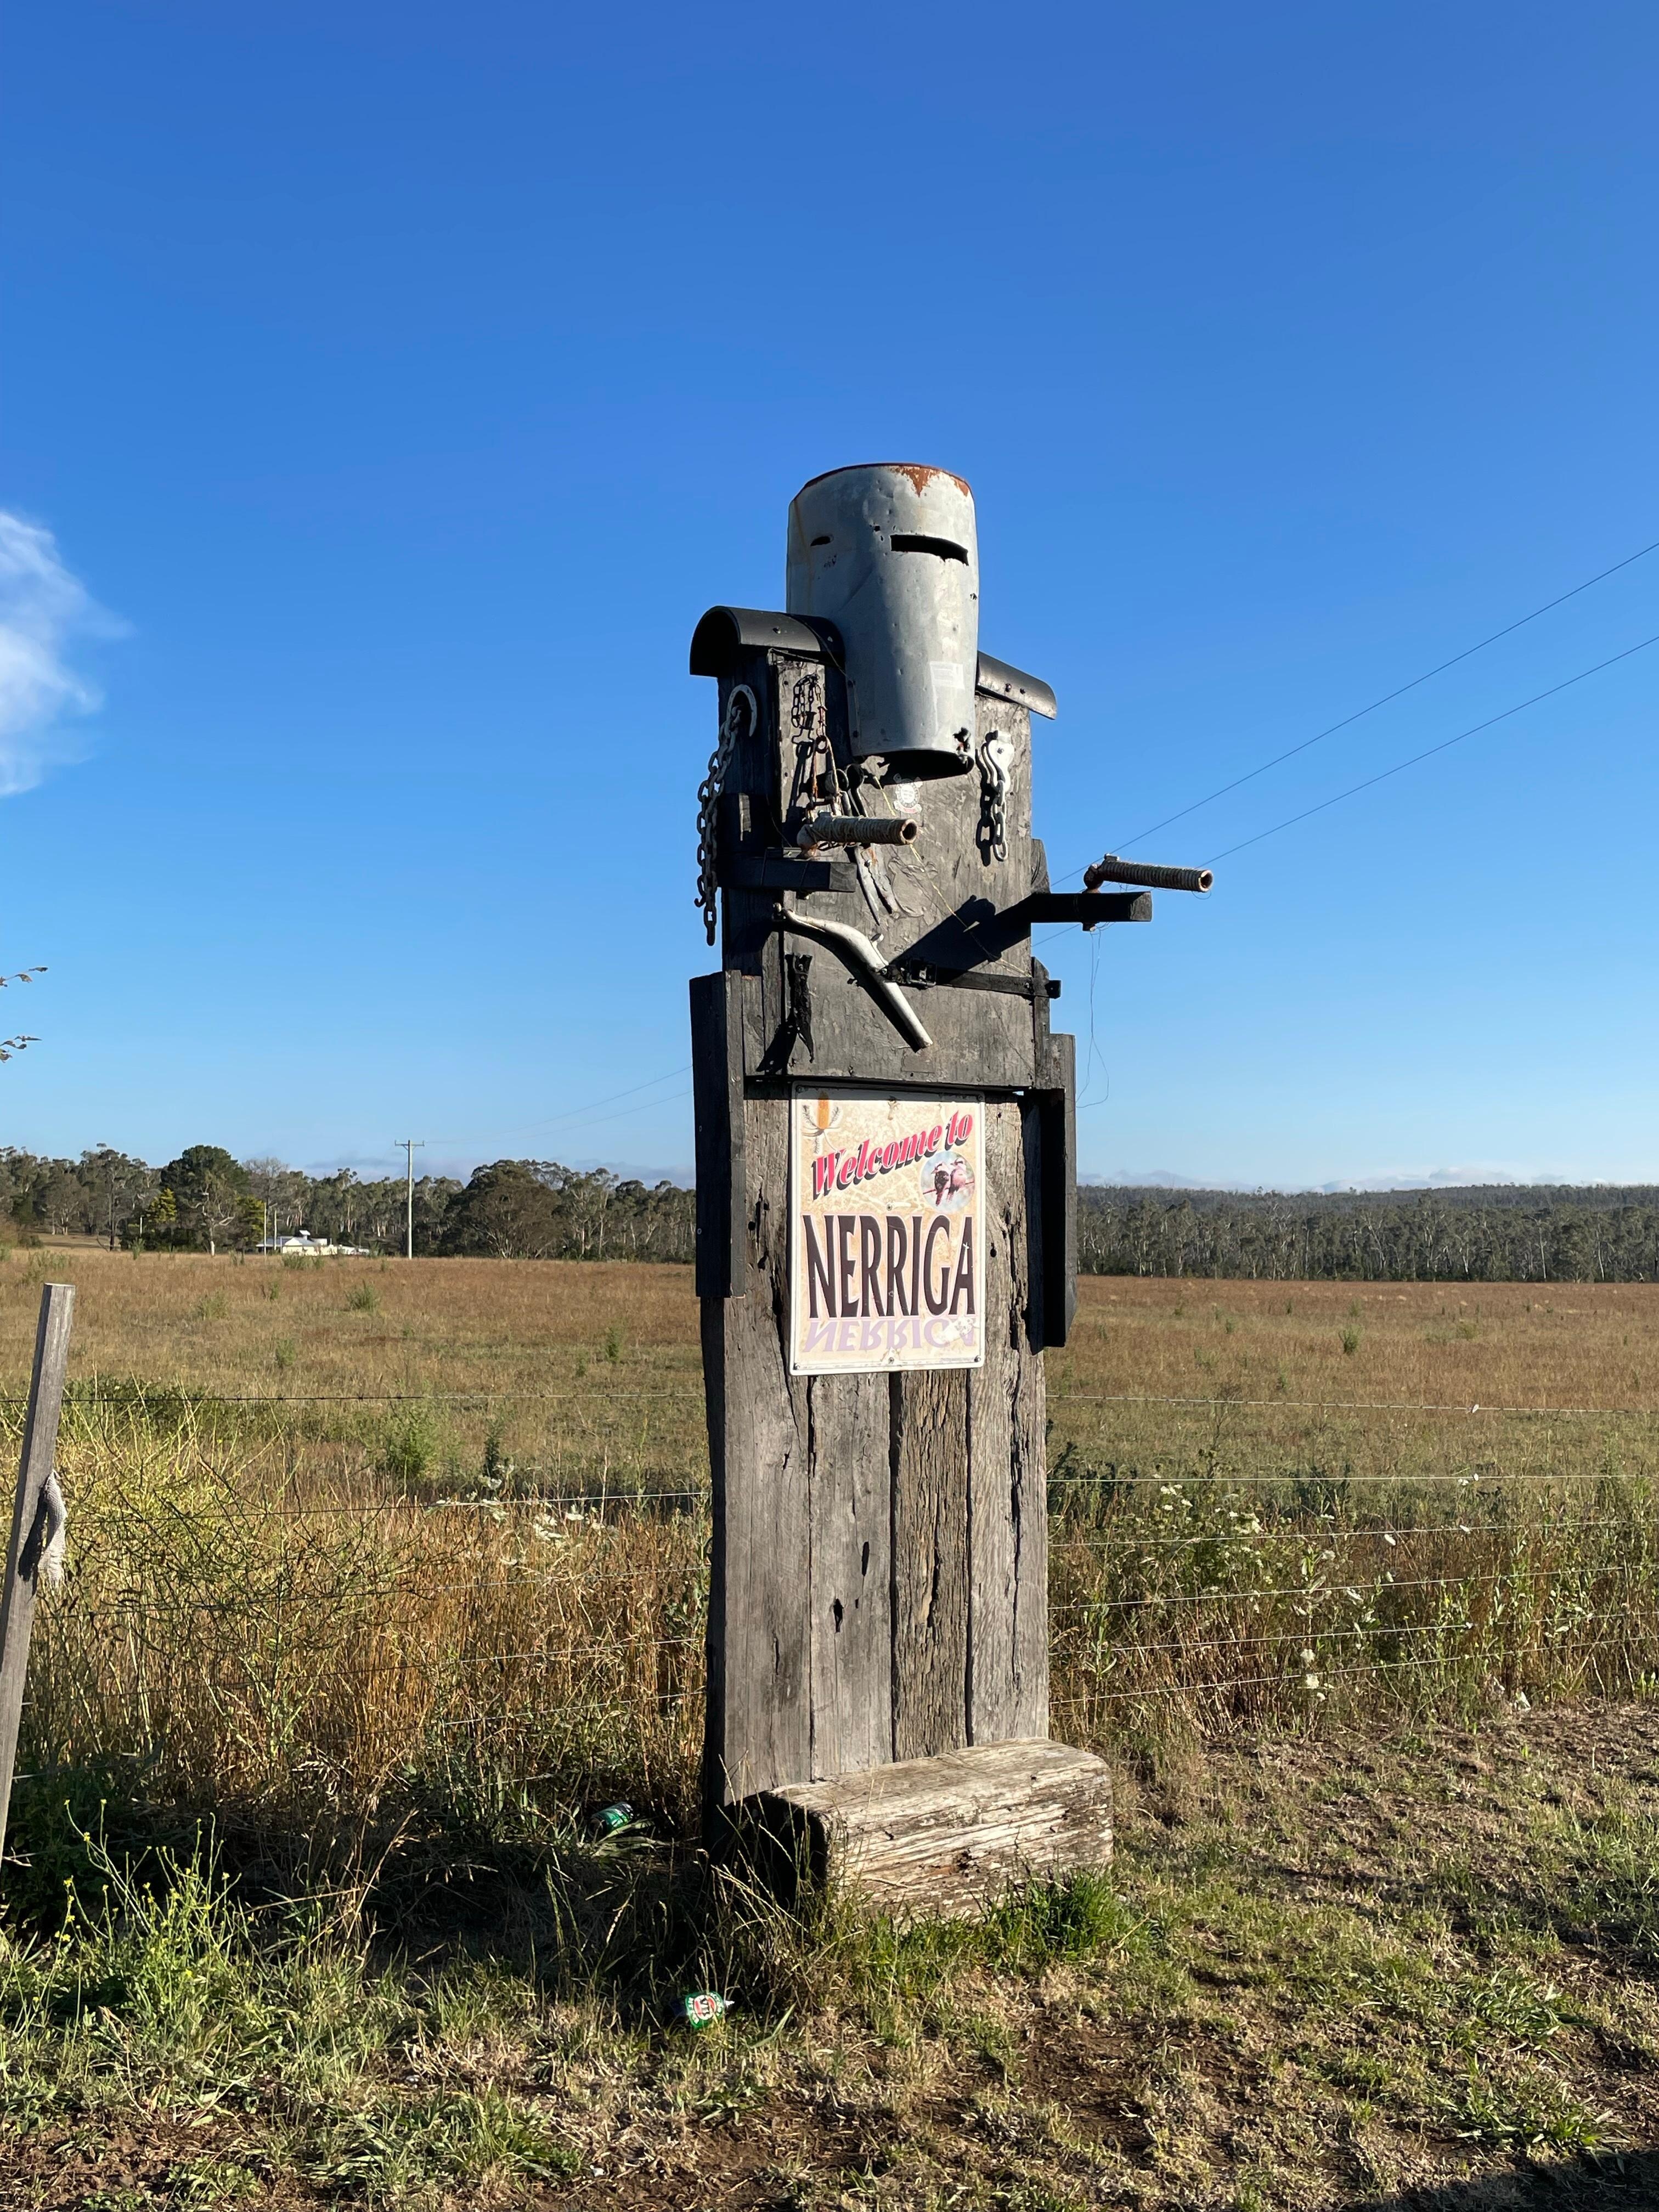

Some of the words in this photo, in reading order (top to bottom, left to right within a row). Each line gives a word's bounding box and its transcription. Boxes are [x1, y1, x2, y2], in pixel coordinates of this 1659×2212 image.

[811, 1125, 943, 1200] Welcome
[945, 1110, 973, 1150] to
[802, 1215, 975, 1318] NERRIGA
